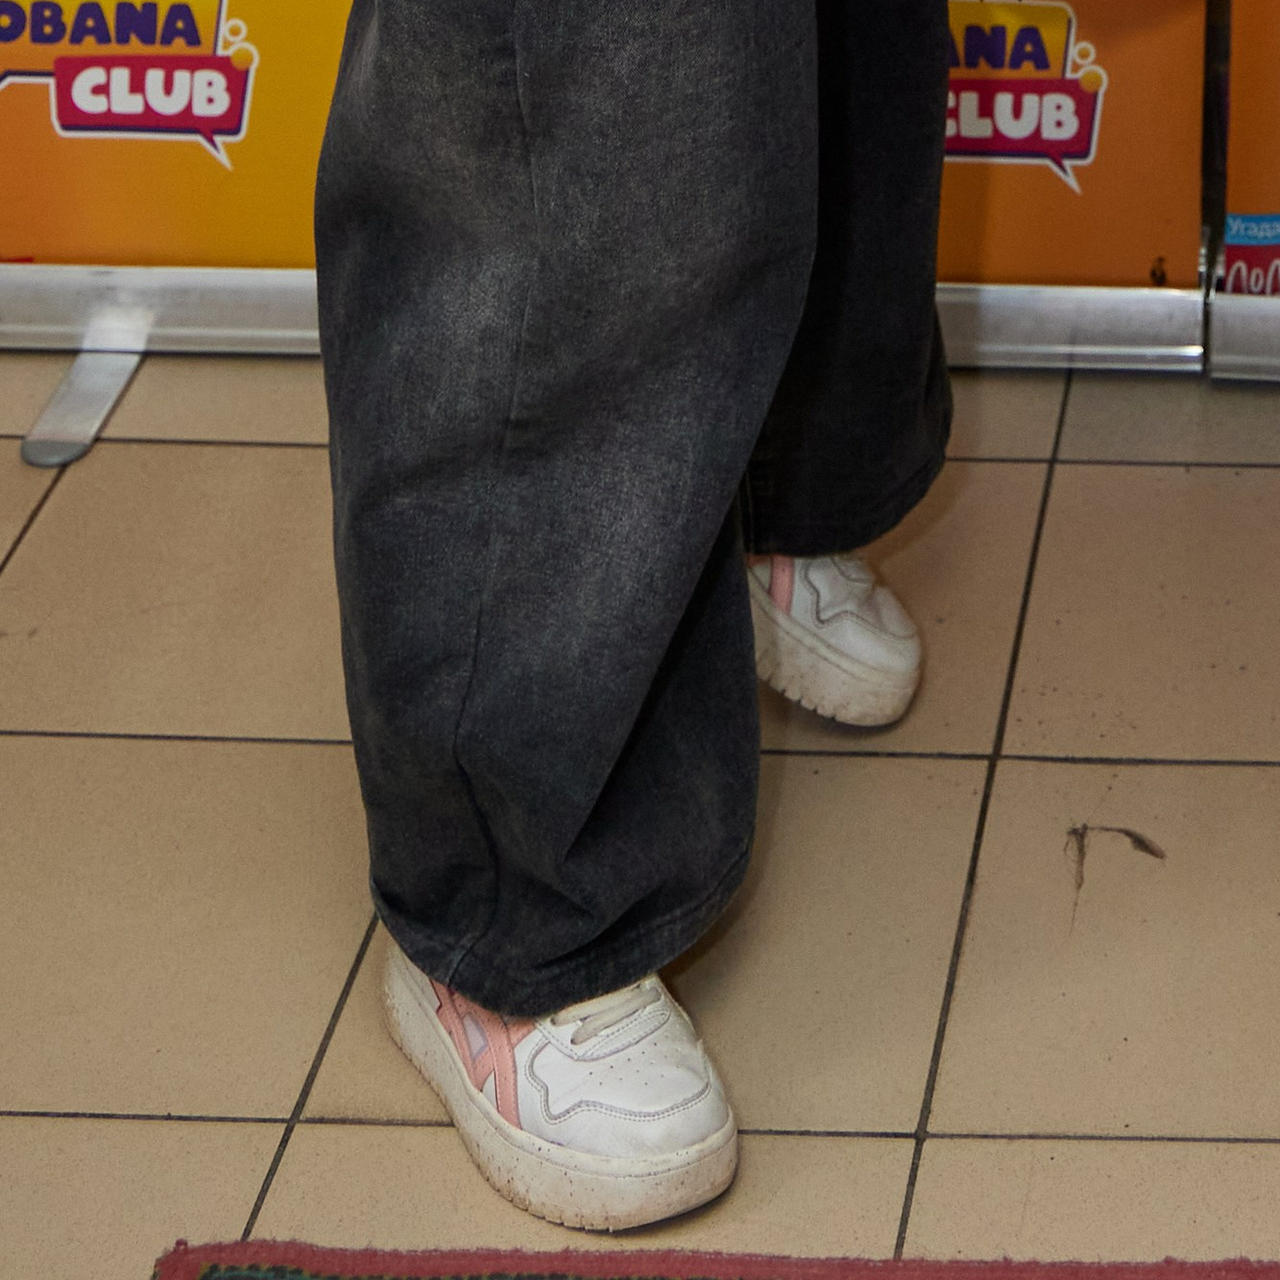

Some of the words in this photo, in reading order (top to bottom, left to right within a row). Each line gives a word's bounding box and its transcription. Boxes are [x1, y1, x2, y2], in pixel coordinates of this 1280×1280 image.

[0, 0, 201, 46] OBANA
[71, 66, 231, 117] CLUB
[946, 91, 1079, 141] LUB
